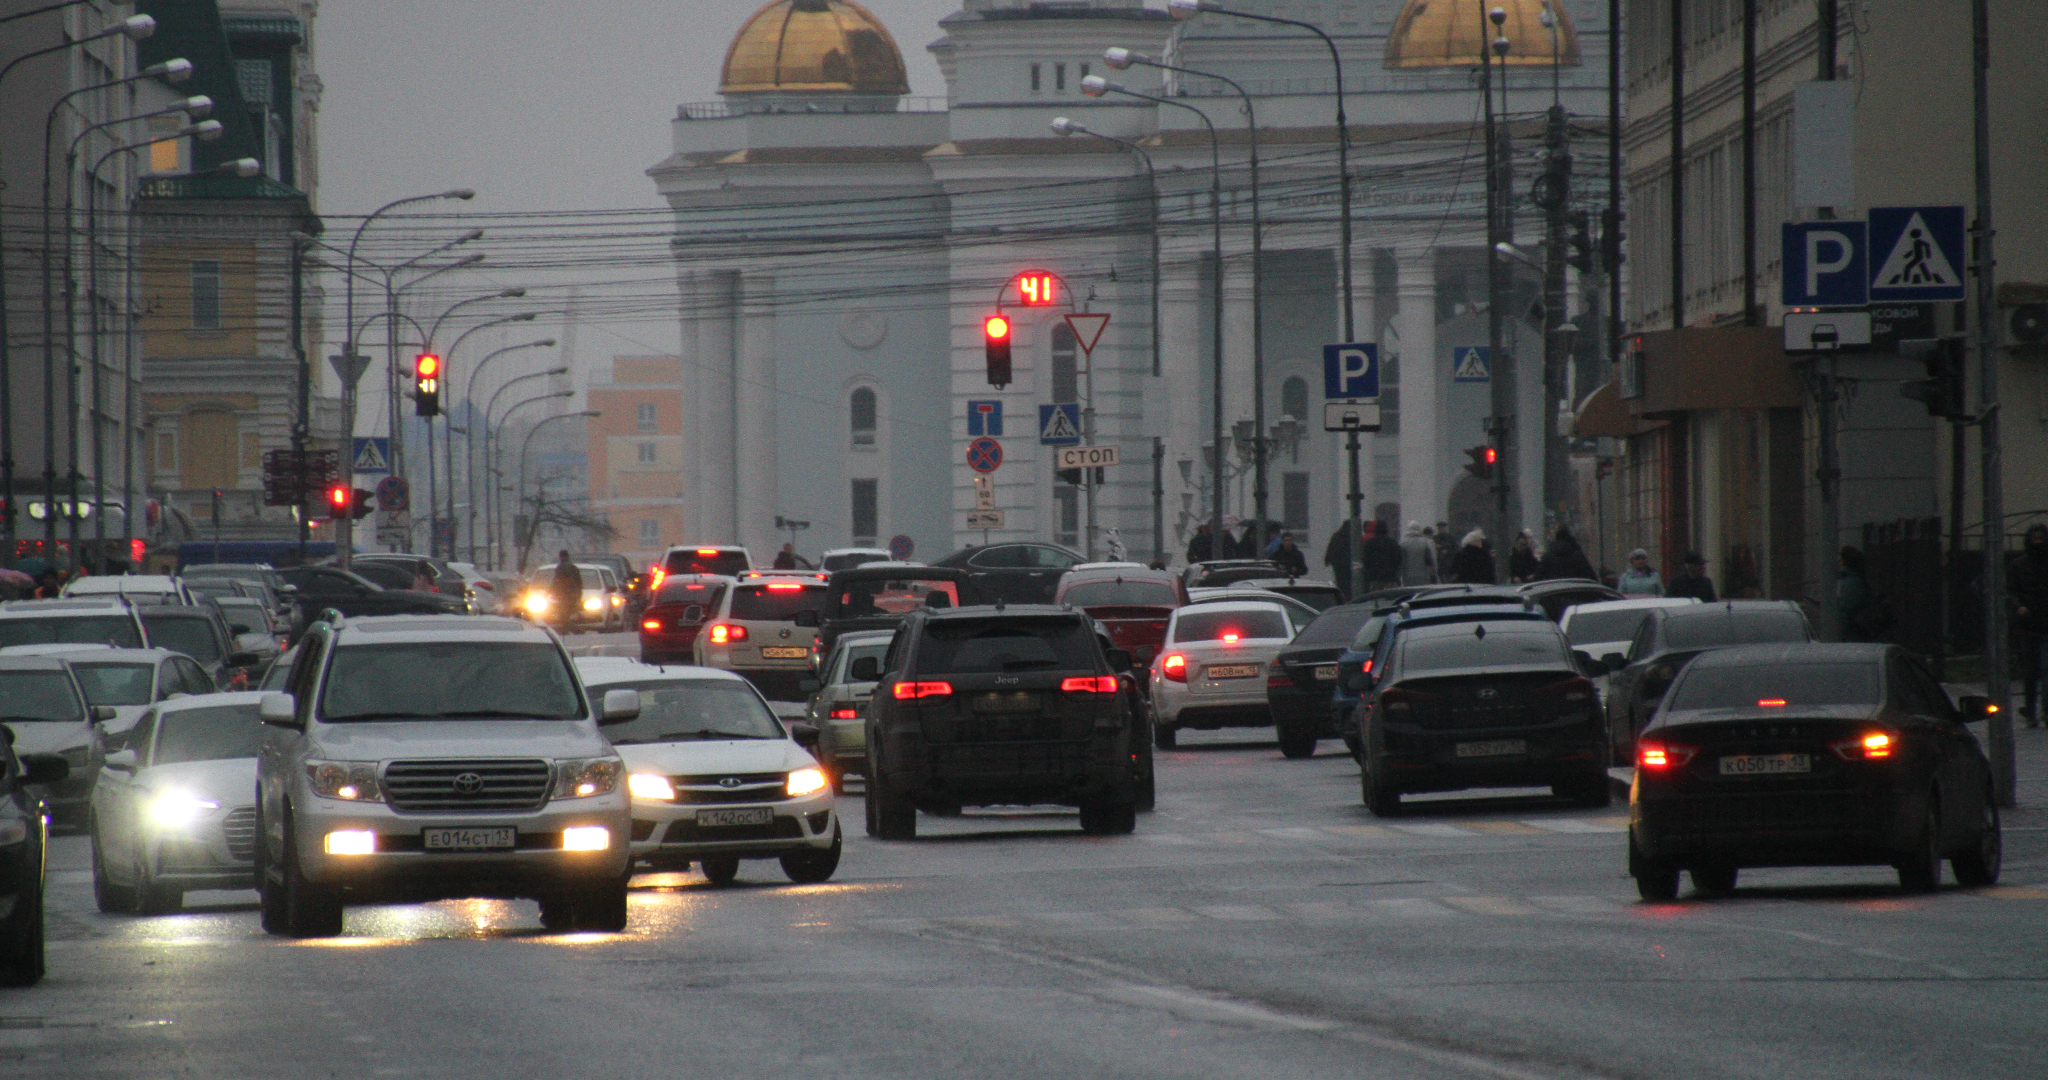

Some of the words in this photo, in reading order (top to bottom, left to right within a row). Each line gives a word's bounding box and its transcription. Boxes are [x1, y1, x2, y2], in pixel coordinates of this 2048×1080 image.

[1806, 230, 1854, 296] P
[1021, 276, 1050, 302] 41
[1339, 349, 1370, 393] P
[1064, 448, 1114, 465] СТОП
[994, 675, 1020, 686] Jeep
